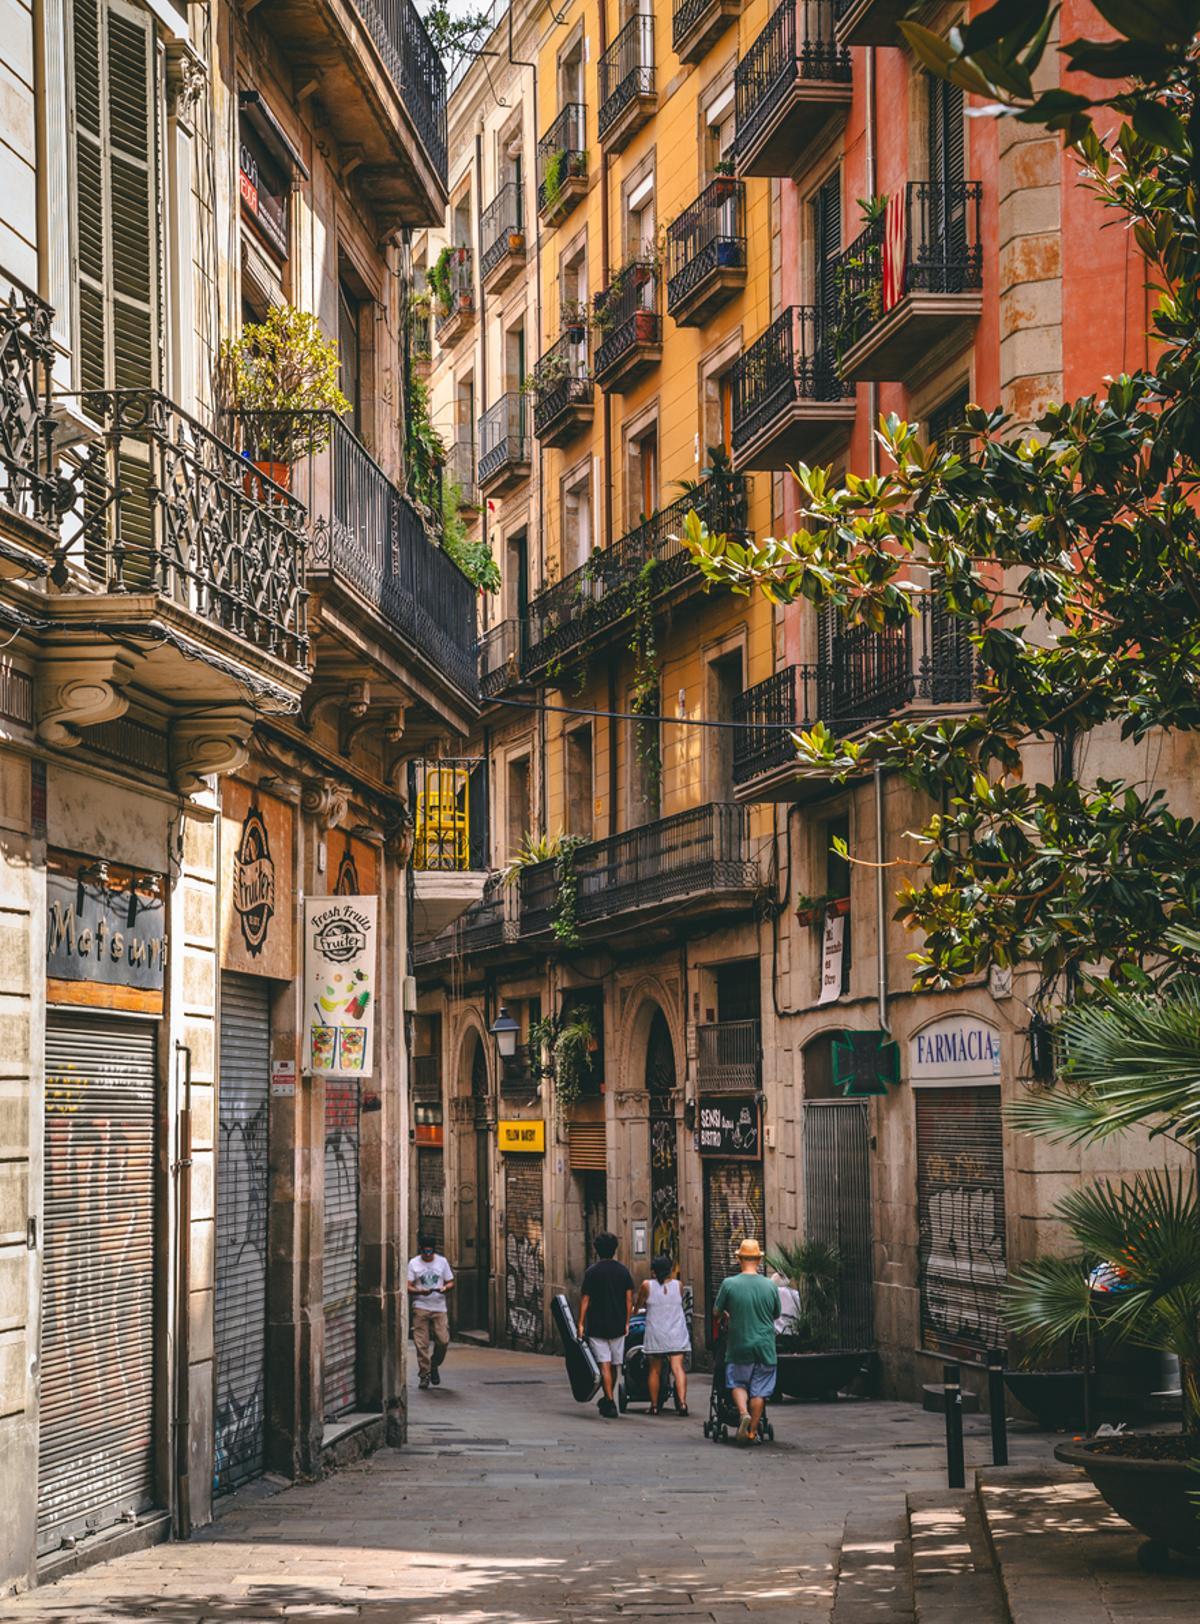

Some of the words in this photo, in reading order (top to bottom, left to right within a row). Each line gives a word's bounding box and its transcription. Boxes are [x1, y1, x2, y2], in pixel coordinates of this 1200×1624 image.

[311, 905, 340, 928] Fresh
[48, 900, 168, 970] Matsuri
[917, 1028, 994, 1064] FARMÀCIA
[701, 1109, 720, 1128] SENSI
[701, 1130, 721, 1147] BISTRO
